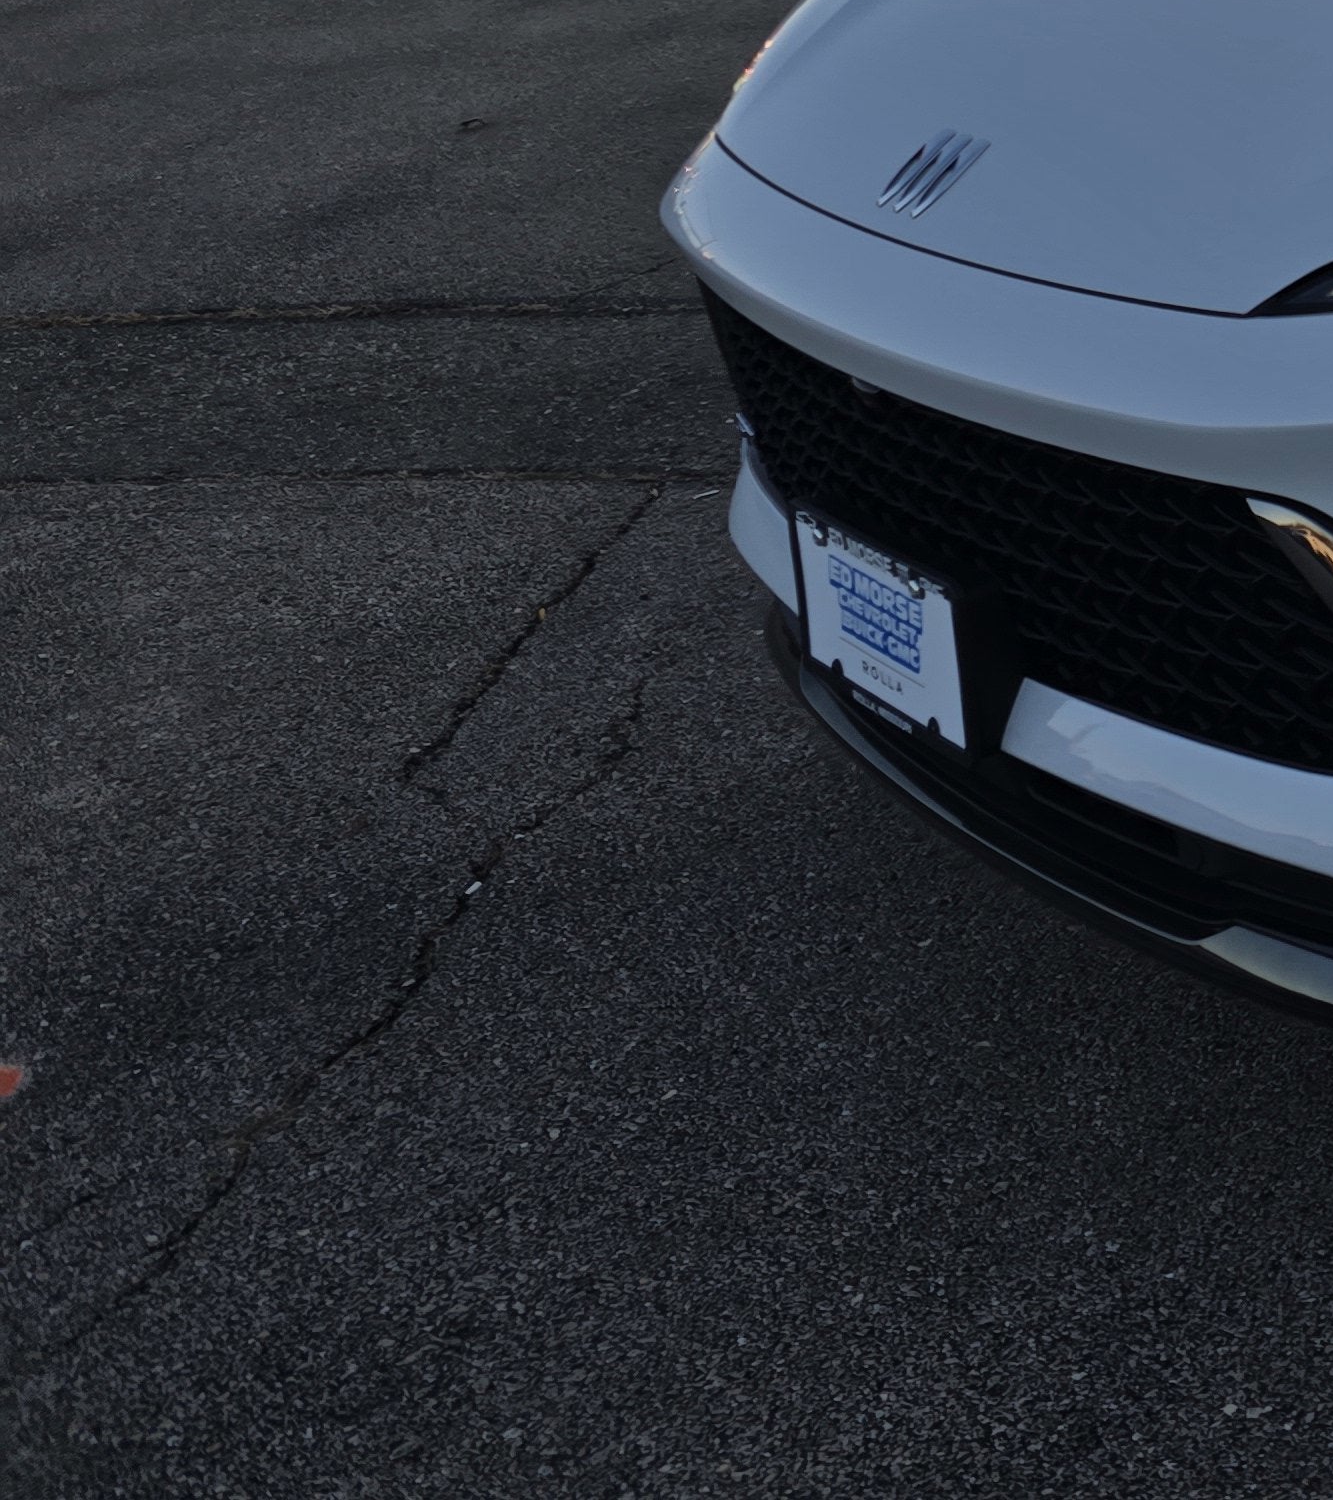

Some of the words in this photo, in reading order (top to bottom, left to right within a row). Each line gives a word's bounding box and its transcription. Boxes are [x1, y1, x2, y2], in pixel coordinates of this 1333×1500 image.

[829, 557, 852, 590] ED
[853, 570, 922, 629] MORSE
[861, 660, 903, 694] ROLLA
